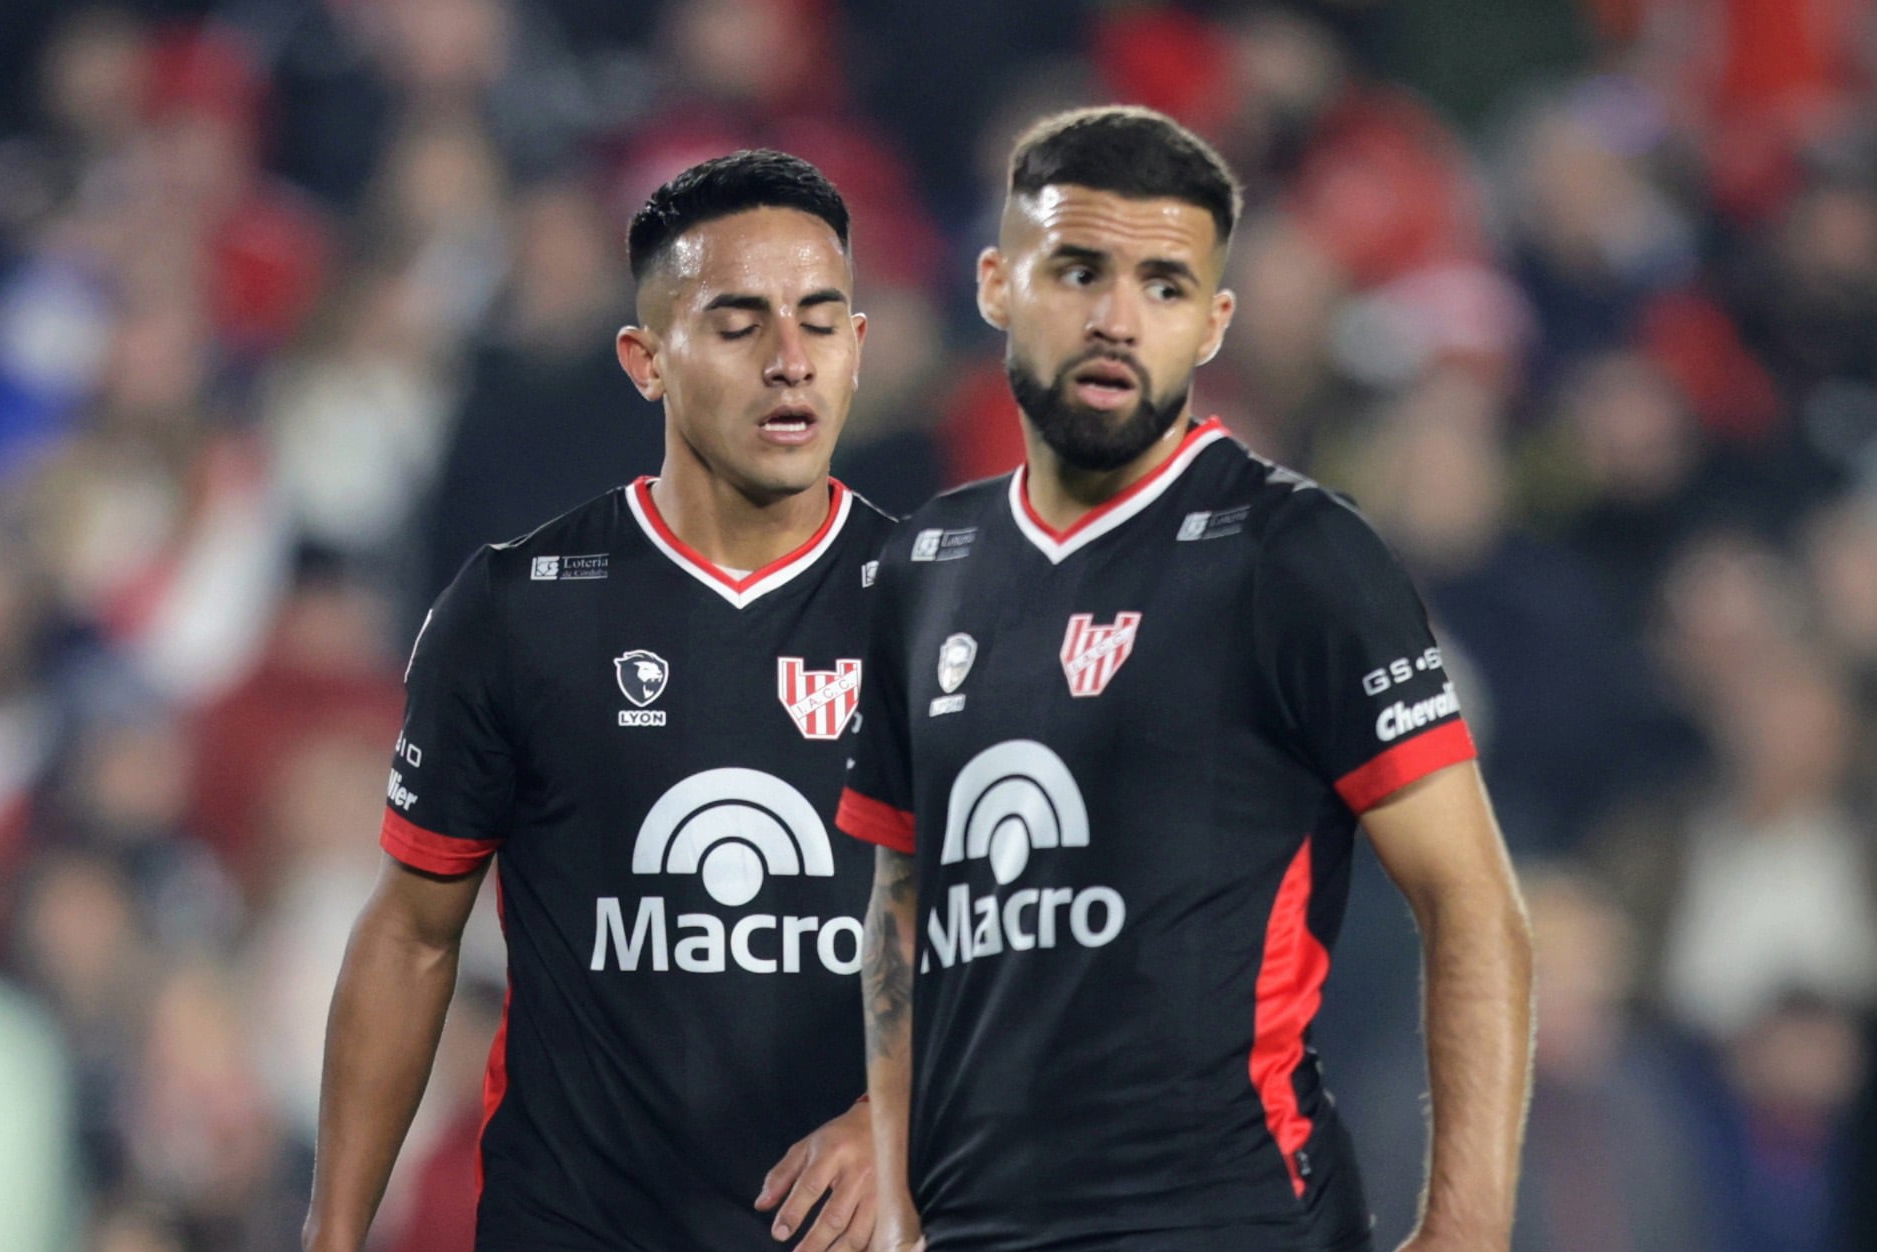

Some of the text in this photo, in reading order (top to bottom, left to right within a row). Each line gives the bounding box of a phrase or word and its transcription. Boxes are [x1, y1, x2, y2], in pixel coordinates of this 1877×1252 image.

[620, 710, 665, 725] LYON
[590, 896, 865, 975] Macro
[920, 883, 1126, 975] Macro
